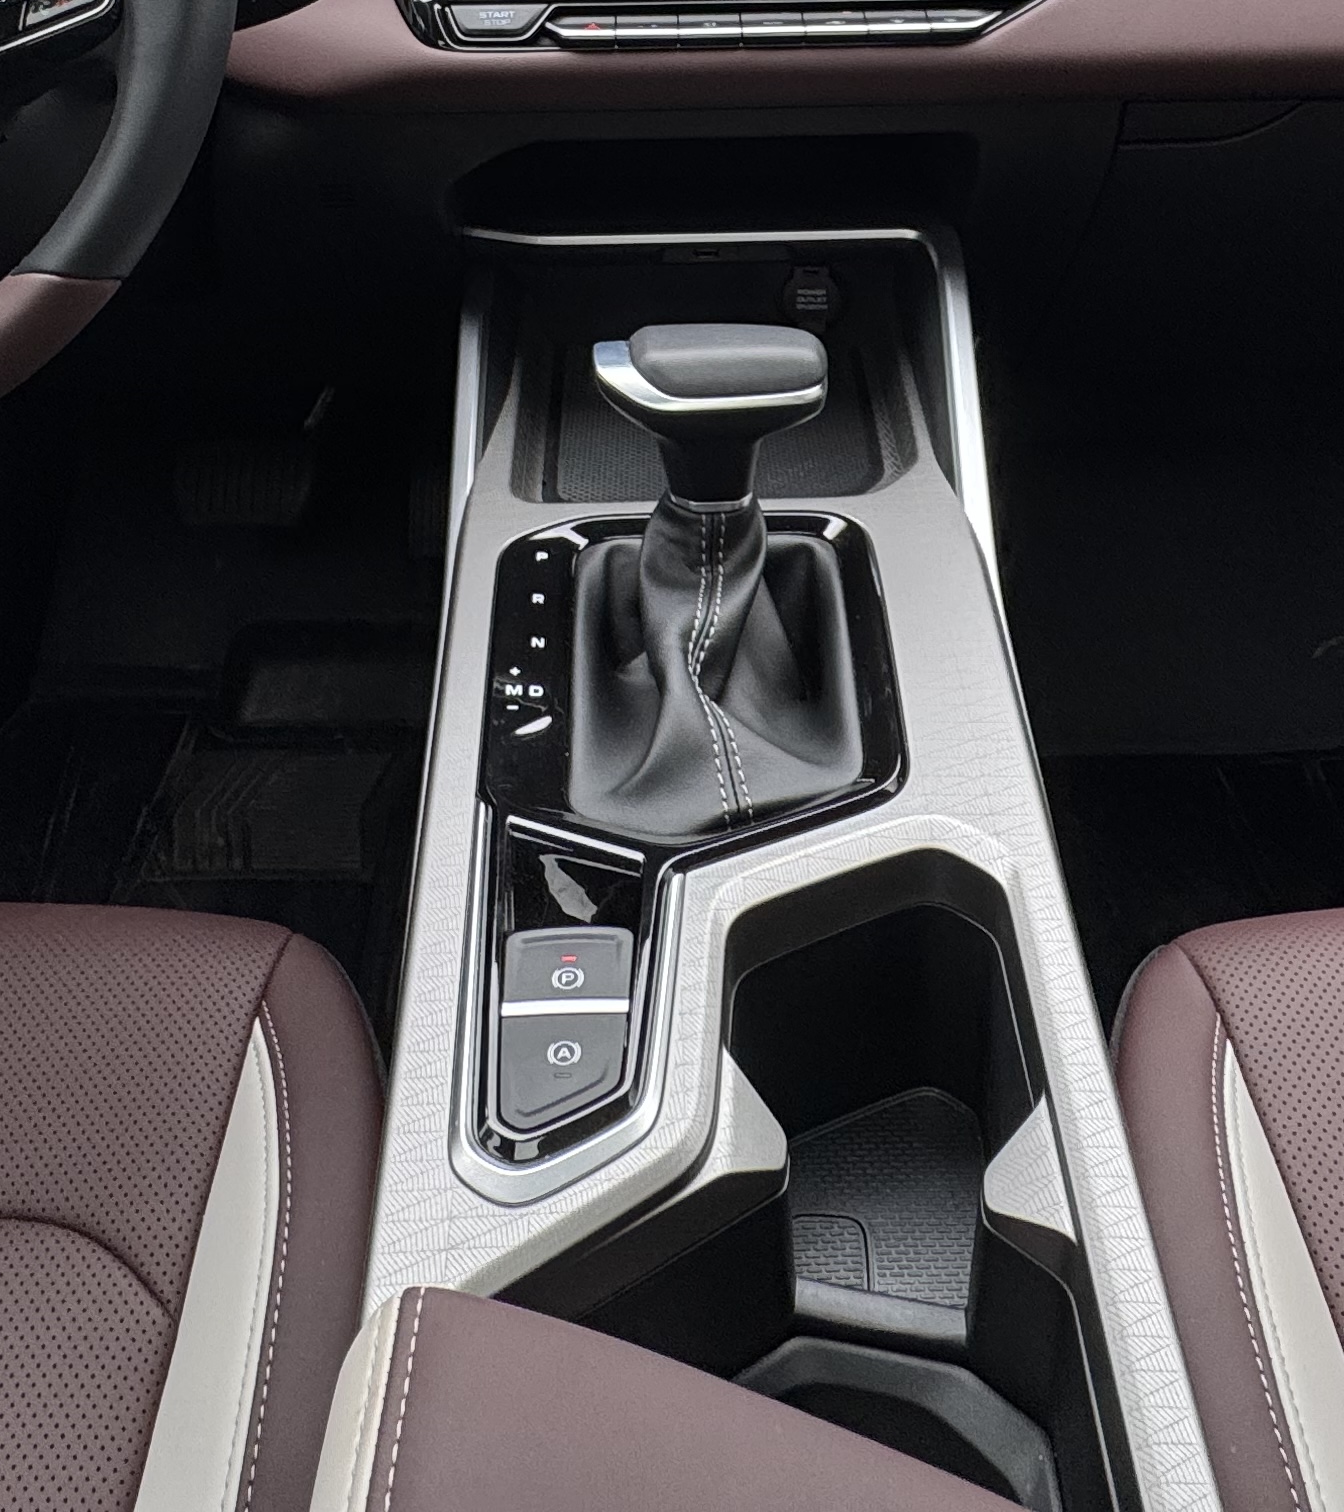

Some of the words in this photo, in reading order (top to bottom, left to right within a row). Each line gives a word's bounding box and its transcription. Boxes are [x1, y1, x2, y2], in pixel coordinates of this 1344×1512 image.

[479, 10, 516, 19] START
[483, 18, 511, 26] STOP
[535, 551, 549, 563] P
[531, 593, 545, 605] R
[530, 637, 546, 649] N
[505, 685, 523, 697] M
[529, 684, 544, 697] D
